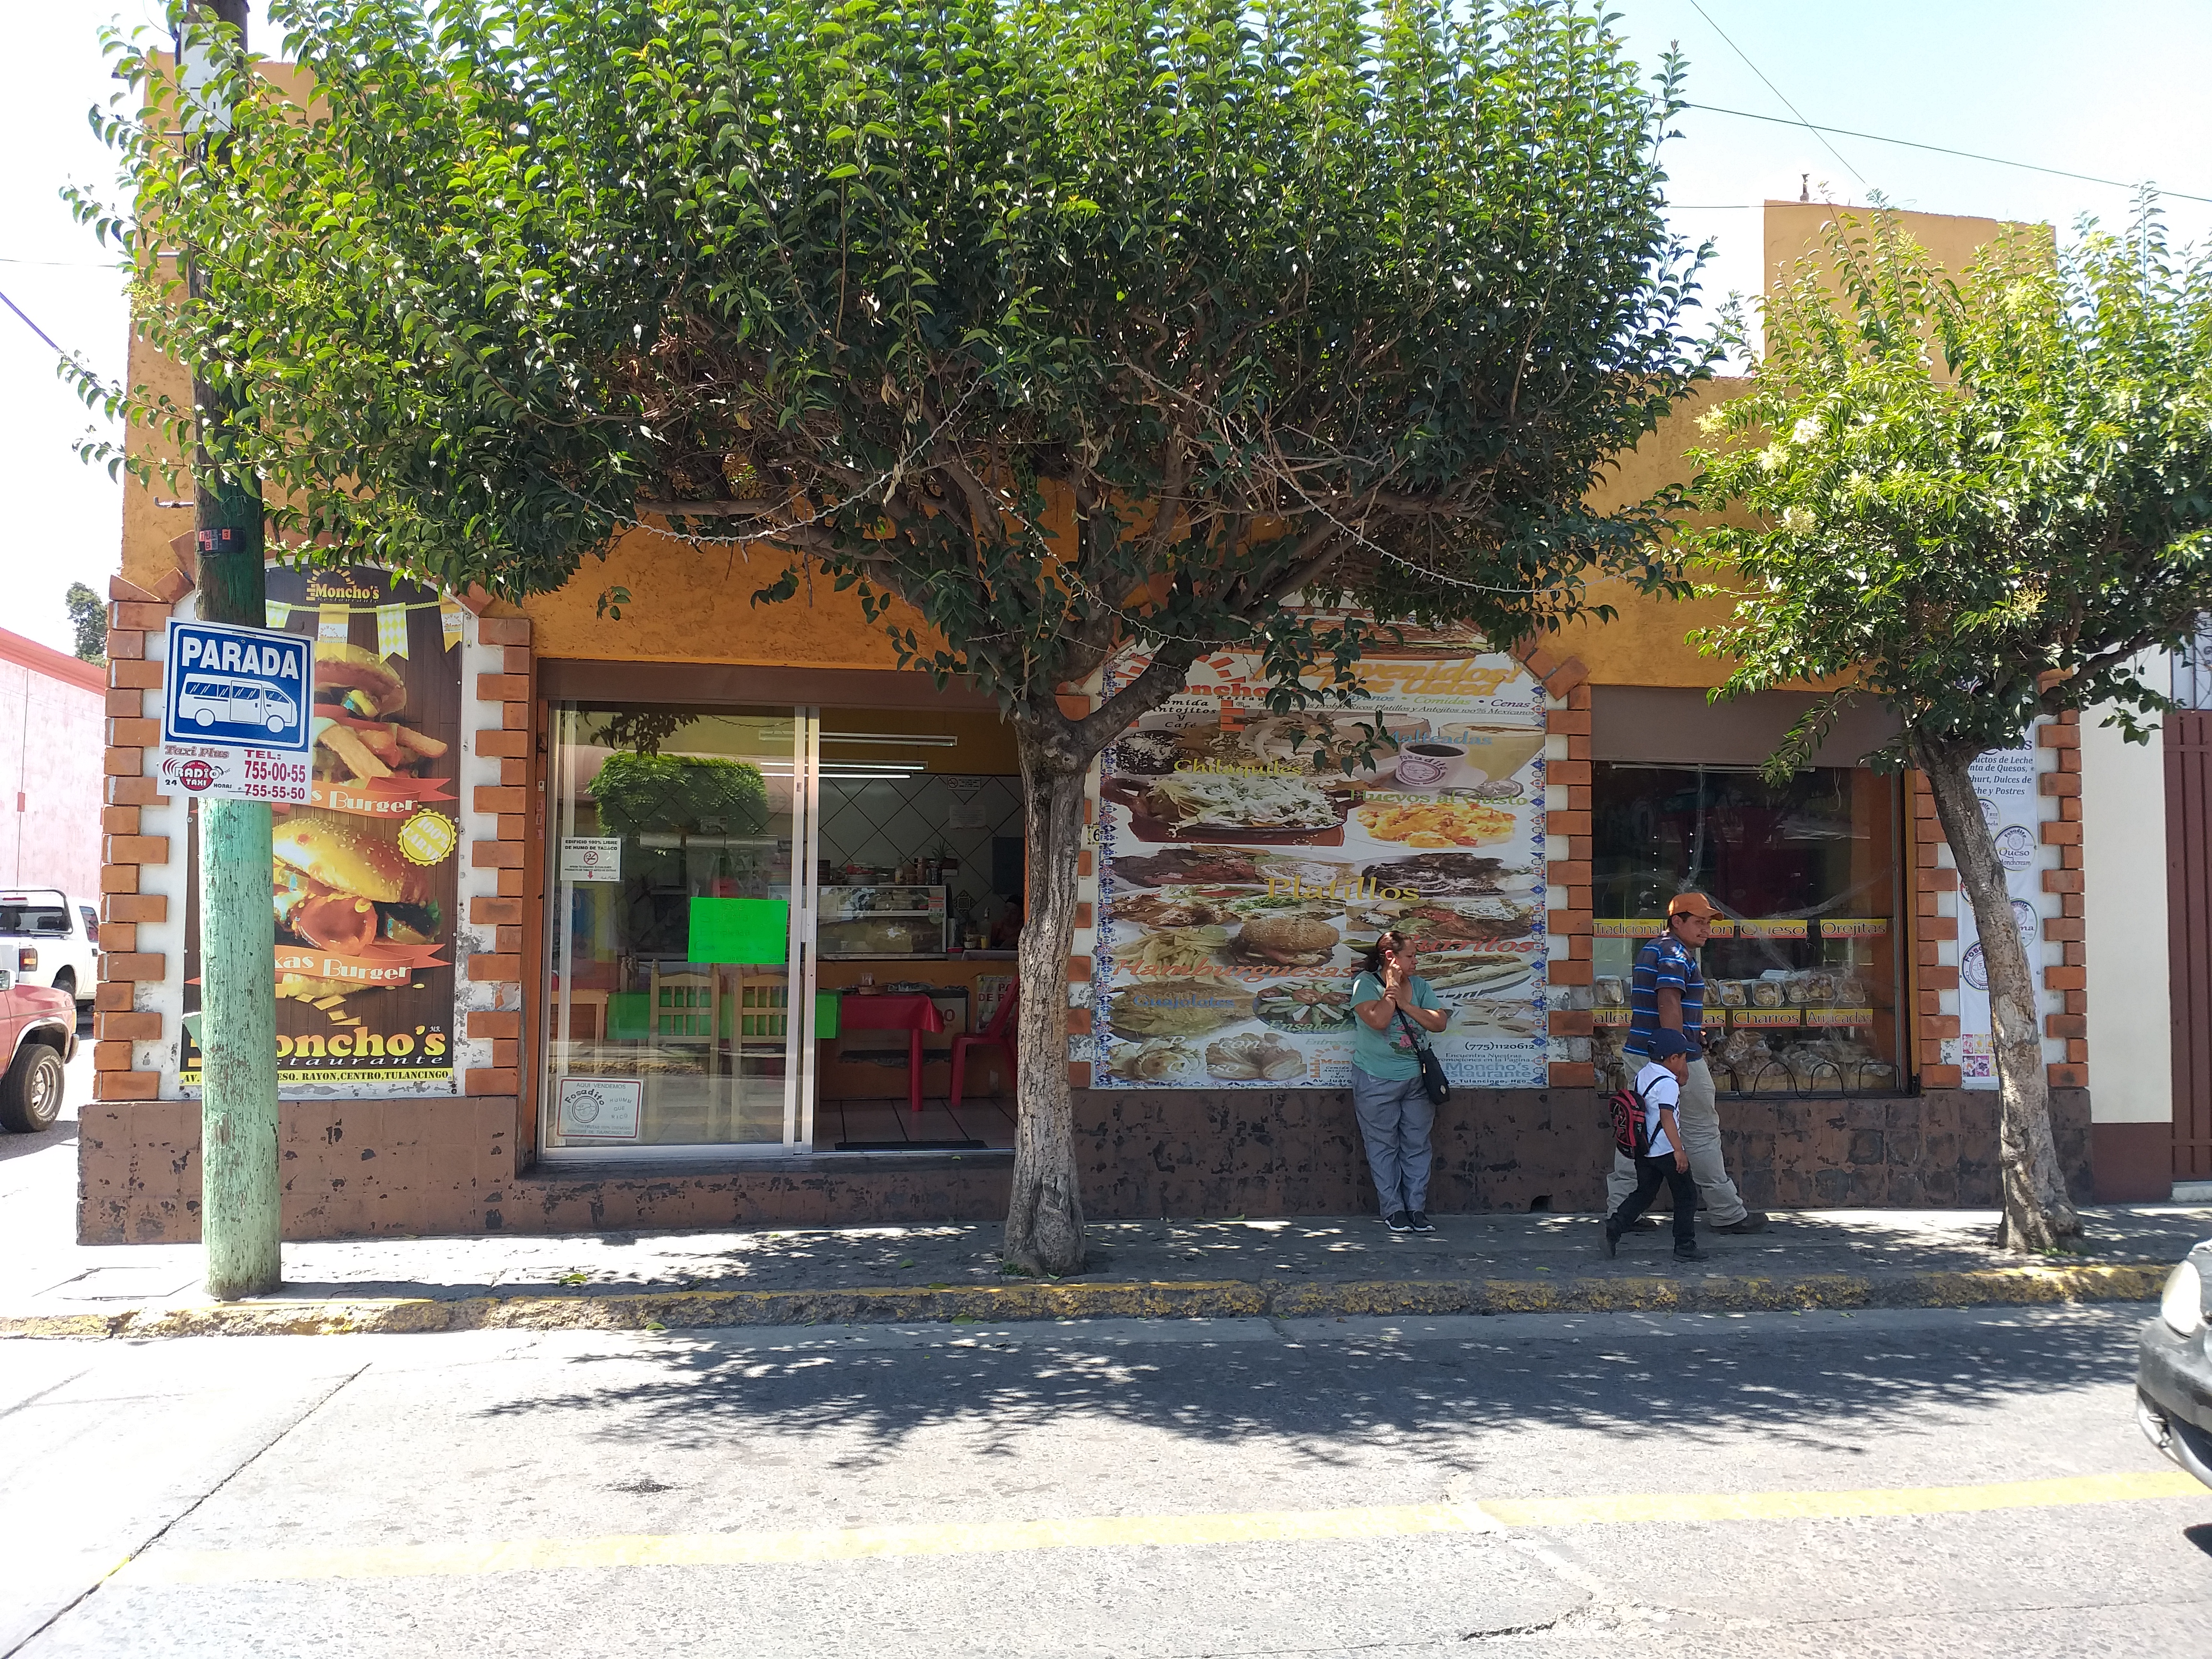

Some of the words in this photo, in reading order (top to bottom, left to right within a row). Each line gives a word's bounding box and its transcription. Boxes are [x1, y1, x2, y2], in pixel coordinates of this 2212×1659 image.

[315, 584, 379, 600] Moncho's
[181, 637, 299, 680] PARADA
[1401, 677, 1503, 697] Usted
[1413, 696, 1472, 705] Comidas
[1491, 699, 1531, 708] Cenas
[1165, 721, 1197, 729] Café
[165, 745, 197, 757] Taxi
[198, 747, 230, 759] Plus
[244, 749, 282, 760] TEL:
[1999, 756, 2009, 764] de
[2010, 756, 2033, 764] Leche
[1174, 758, 1302, 778] Chilaquiles
[1985, 764, 1995, 772] de
[1996, 764, 2028, 773] Quesos,
[1994, 775, 2020, 784] Dulces
[2021, 776, 2032, 784] de
[1348, 789, 1431, 803] Huevos
[1436, 790, 1456, 804] al
[1463, 792, 1528, 806] Gusto
[1995, 787, 2026, 795] Postres
[329, 791, 418, 813] Burger
[417, 817, 451, 850] 100%
[2004, 828, 2027, 839] Fosadito
[1999, 848, 2030, 858] Queso
[1264, 875, 1419, 902] Platillos
[1594, 923, 1663, 935] Tradicional
[1741, 923, 1806, 937] Queso
[1821, 922, 1886, 937] Orejitas
[1409, 934, 1537, 953] urritos
[323, 959, 412, 980] Burger
[1113, 958, 1355, 983] Hamburguesas
[978, 993, 993, 1002] DE
[1133, 994, 1235, 1009] Guajolotes
[1733, 1011, 1799, 1024] Charros
[1807, 1011, 1873, 1024] Arracadas
[276, 1025, 446, 1058] oncho's
[1218, 1040, 1261, 1050] con
[1465, 1041, 1535, 1051] (775)1120612
[276, 1055, 444, 1066] staurante
[1445, 1062, 1530, 1071] Moncho's
[184, 1074, 200, 1082] AV.
[1444, 1070, 1532, 1078] estaurante
[565, 1089, 605, 1106] Fosadito
